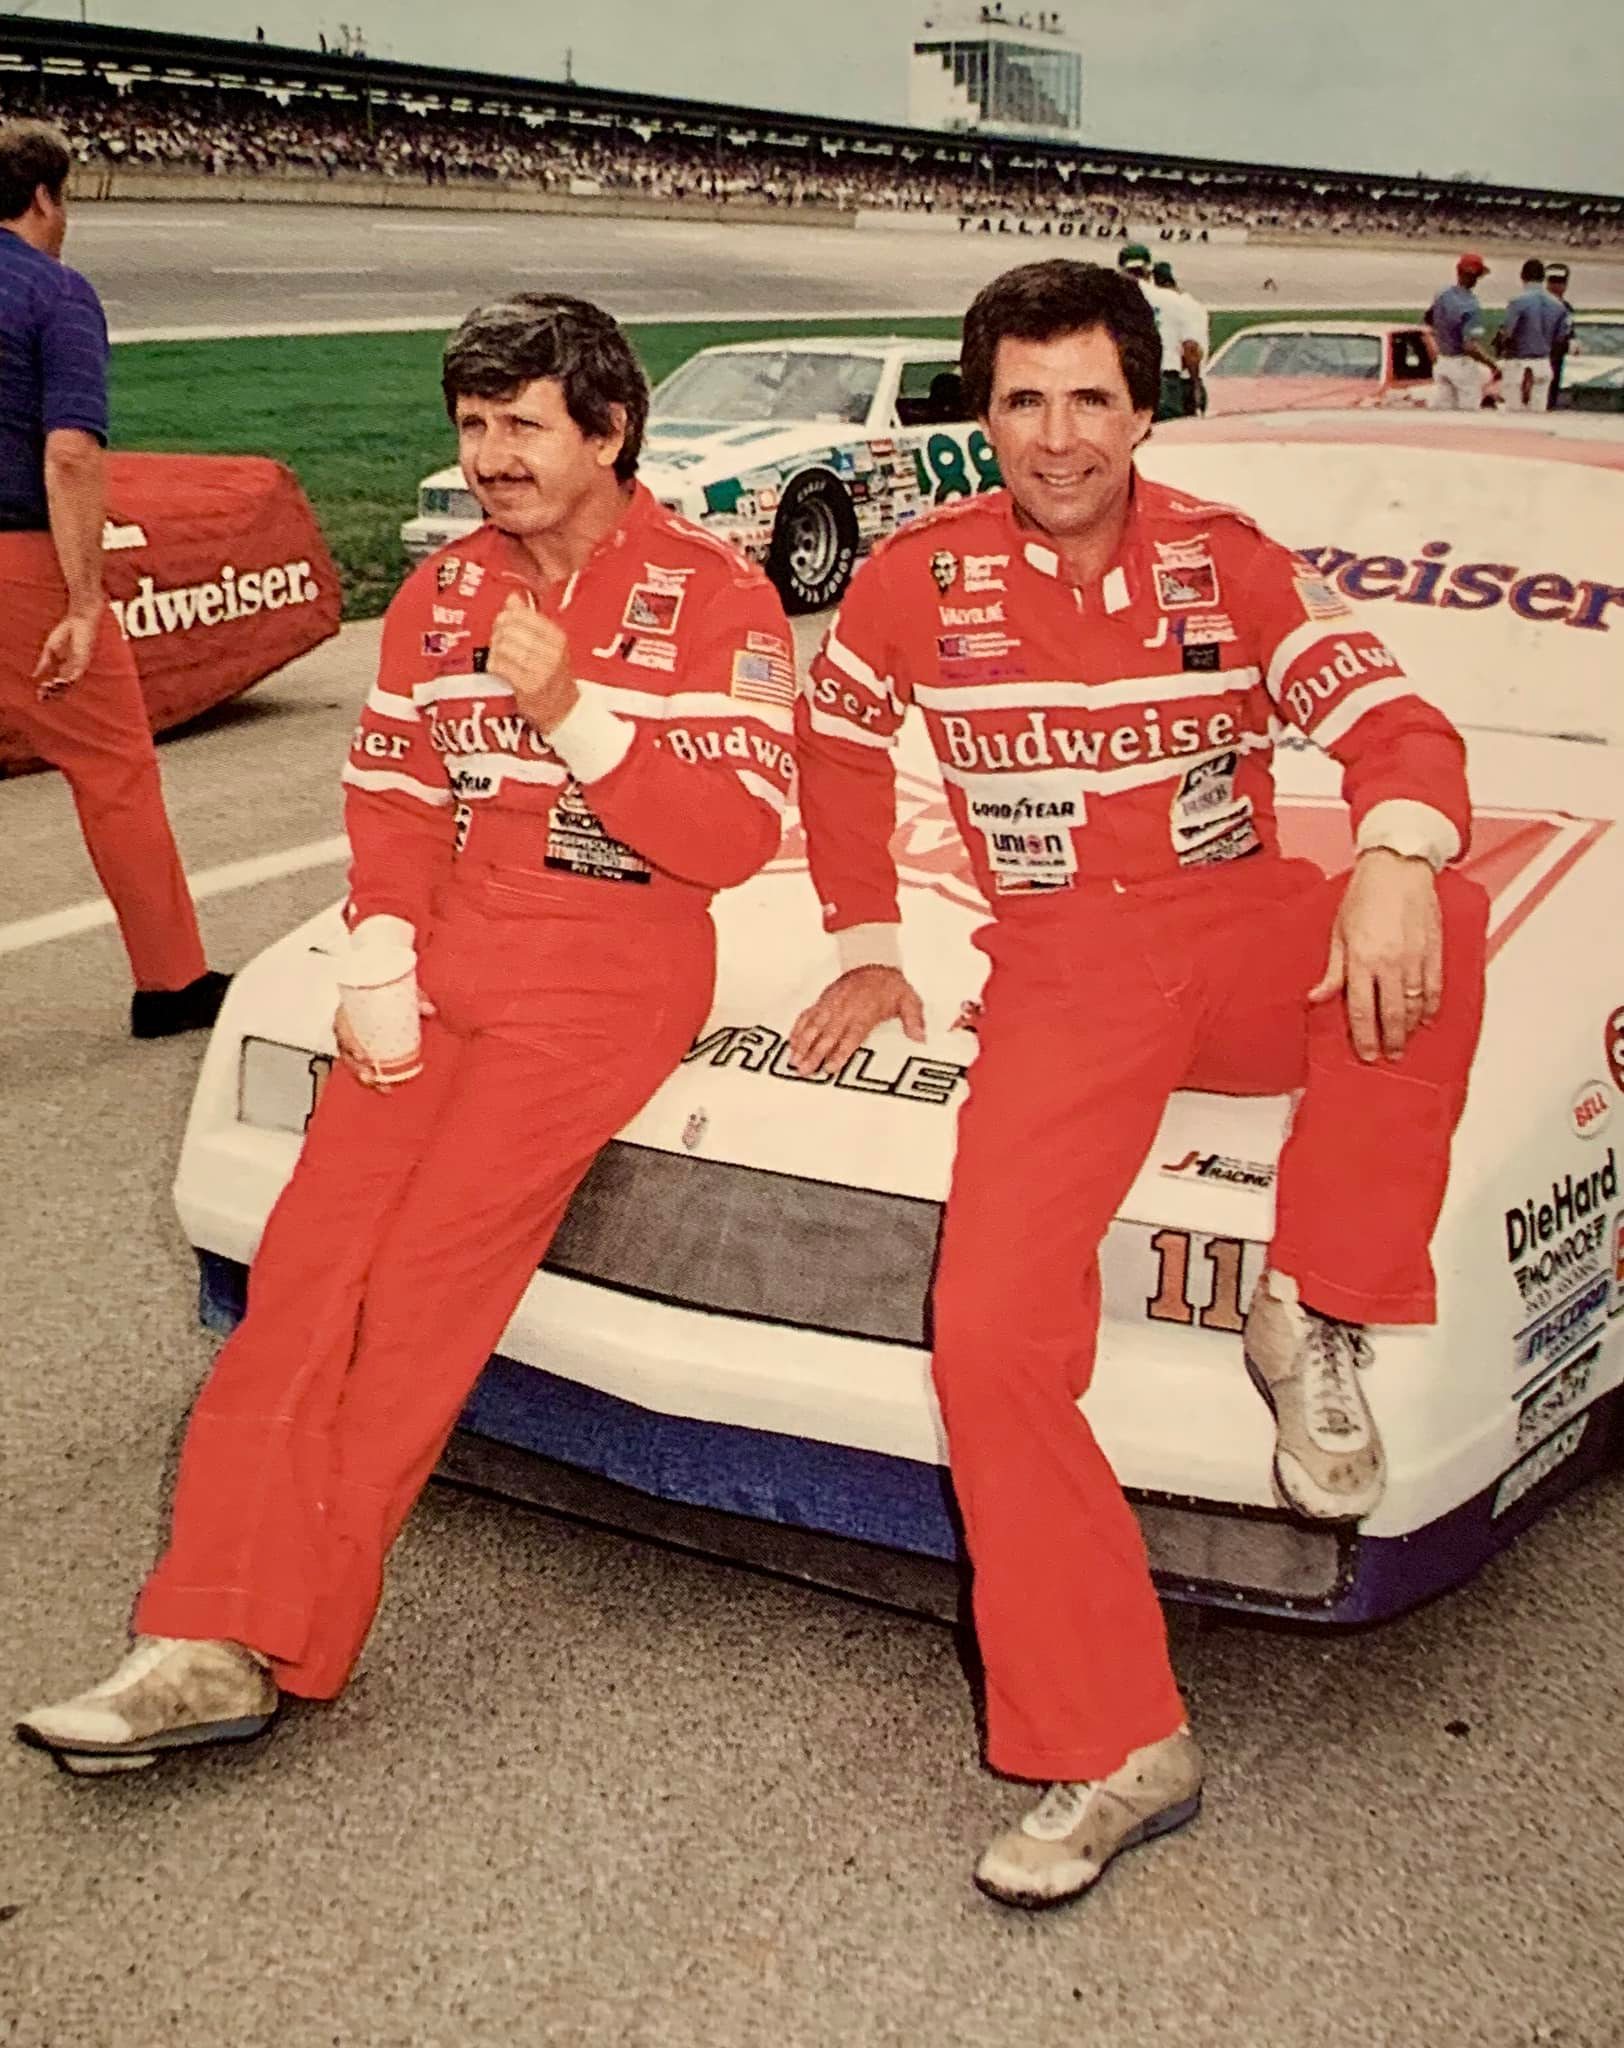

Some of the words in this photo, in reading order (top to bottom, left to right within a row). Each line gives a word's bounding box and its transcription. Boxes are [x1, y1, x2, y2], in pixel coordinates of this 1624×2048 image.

[1159, 228, 1209, 242] USA
[941, 708, 1240, 769] Budweise
[1505, 1148, 1618, 1263] DieHard
[1146, 1228, 1249, 1334] 11
